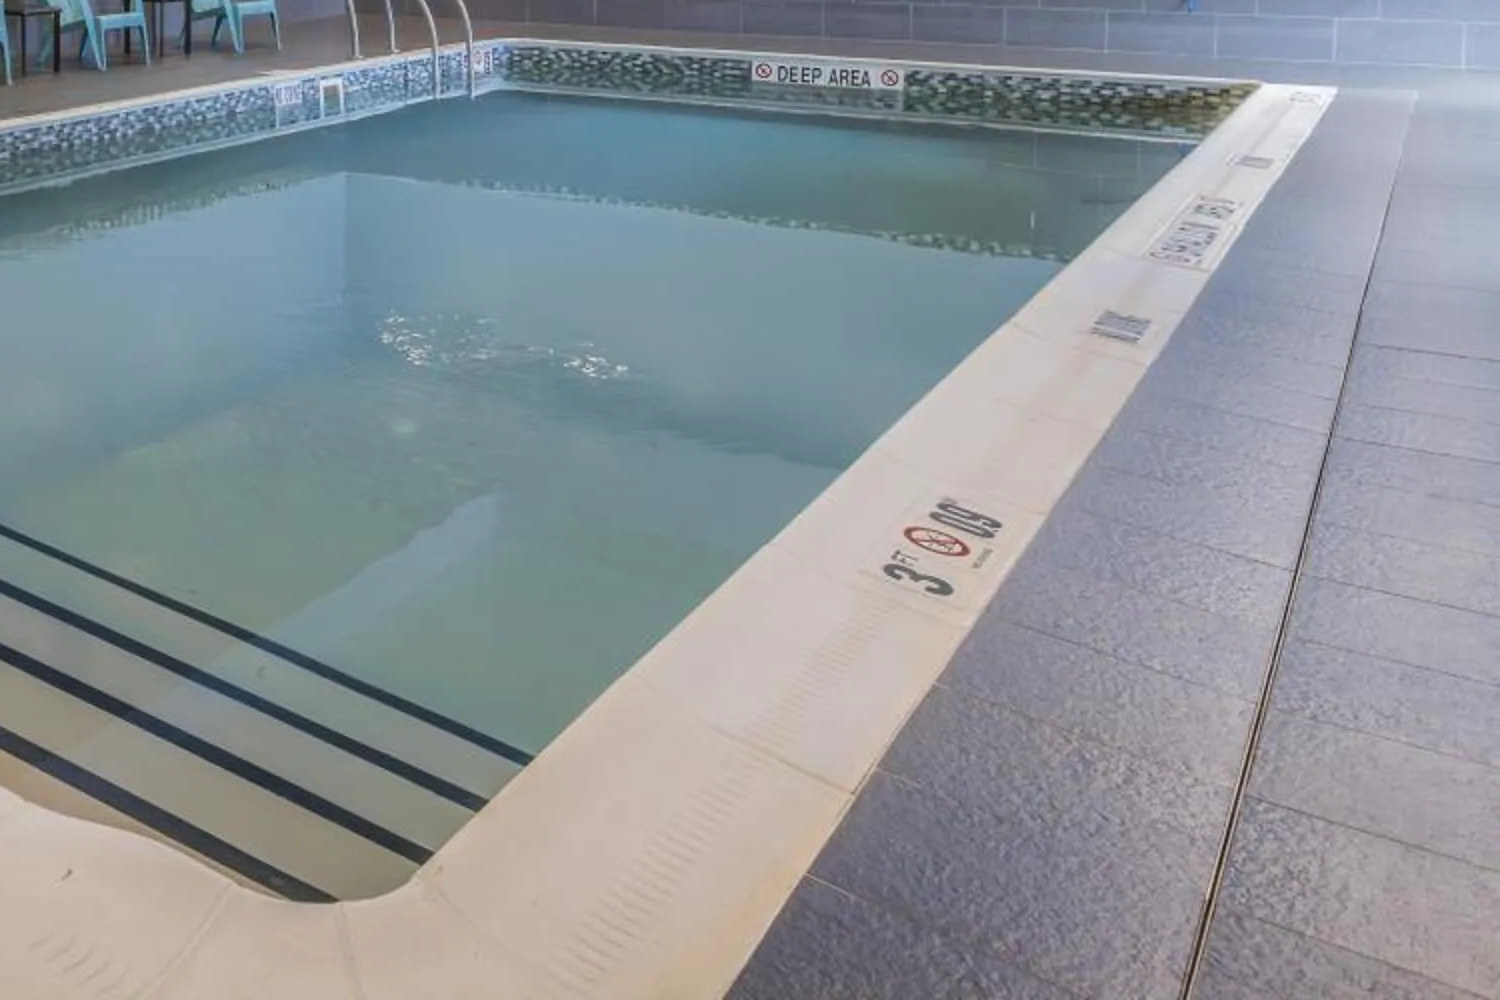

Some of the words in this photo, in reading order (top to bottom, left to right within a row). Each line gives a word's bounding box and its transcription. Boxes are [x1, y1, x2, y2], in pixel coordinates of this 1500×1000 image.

[777, 65, 822, 83] DEEP
[828, 68, 871, 87] AREA
[883, 563, 954, 596] 3
